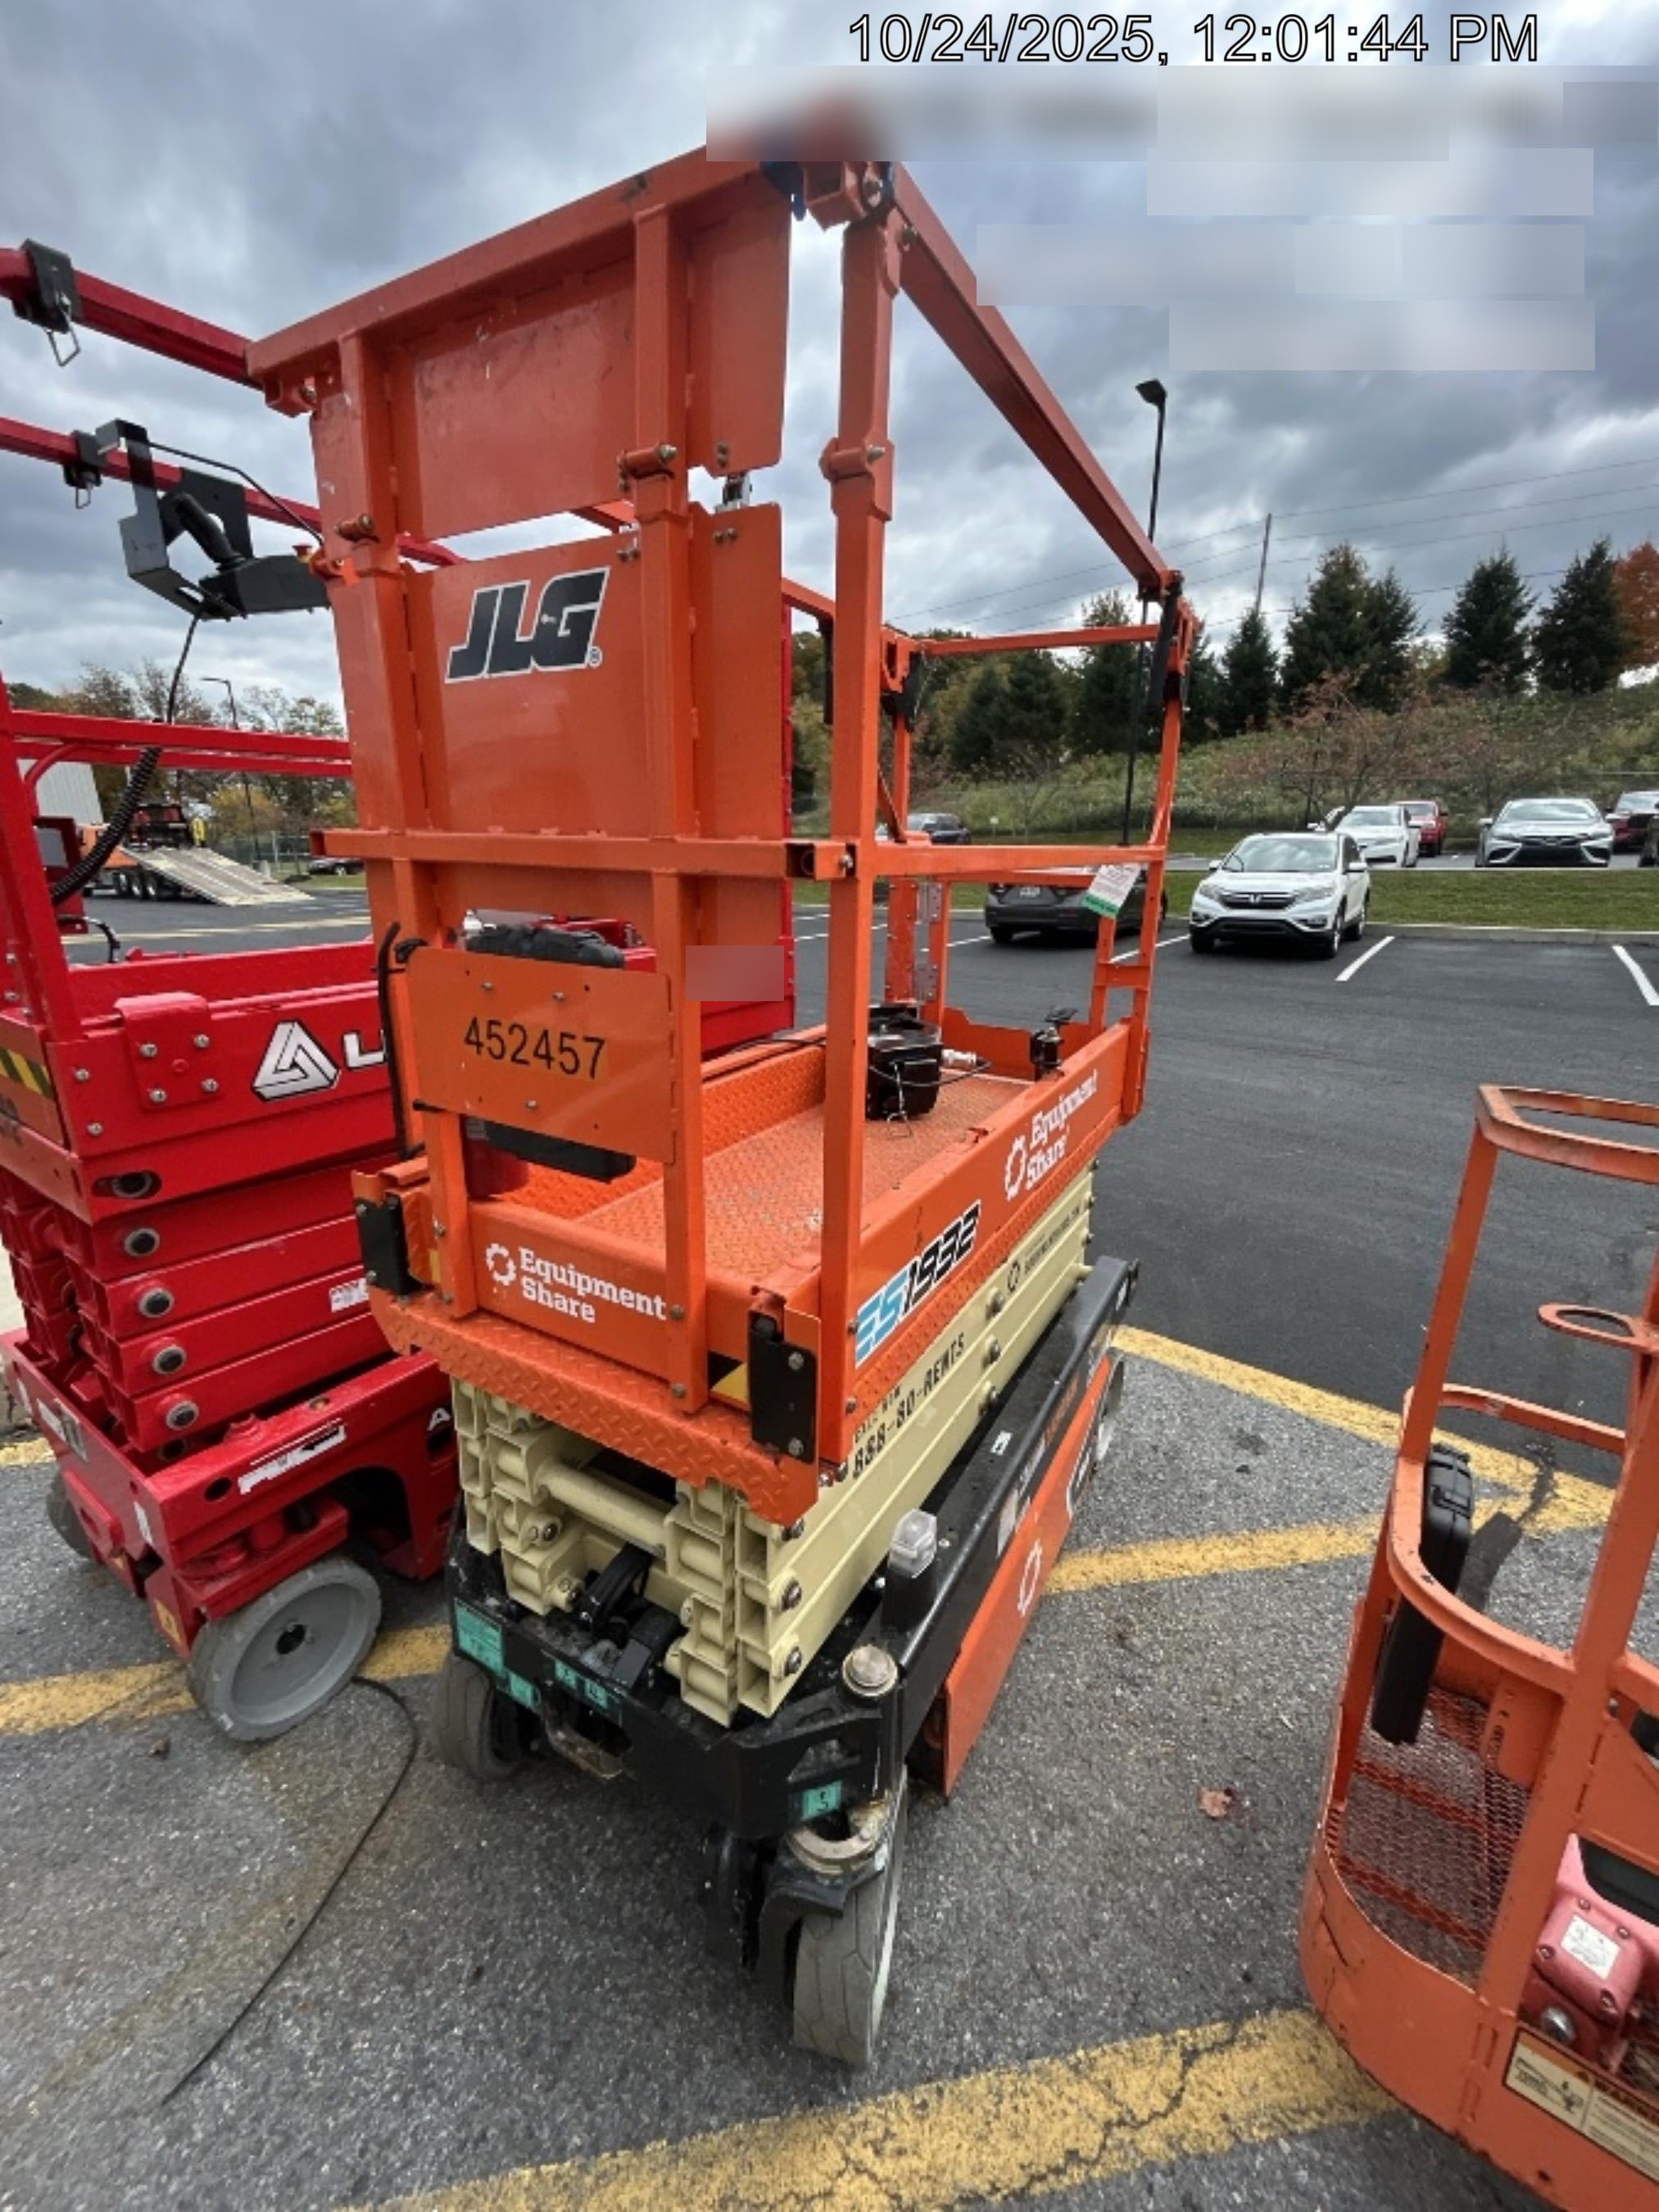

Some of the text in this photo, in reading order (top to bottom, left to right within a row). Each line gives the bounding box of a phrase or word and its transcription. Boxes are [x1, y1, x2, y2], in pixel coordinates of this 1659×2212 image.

[465, 1015, 606, 1080] 452457
[1030, 1068, 1098, 1149] Equipment
[1026, 1132, 1067, 1190] Share
[519, 1245, 667, 1321] Equipment
[521, 1276, 596, 1323] Share
[855, 1198, 981, 1370] ES1932
